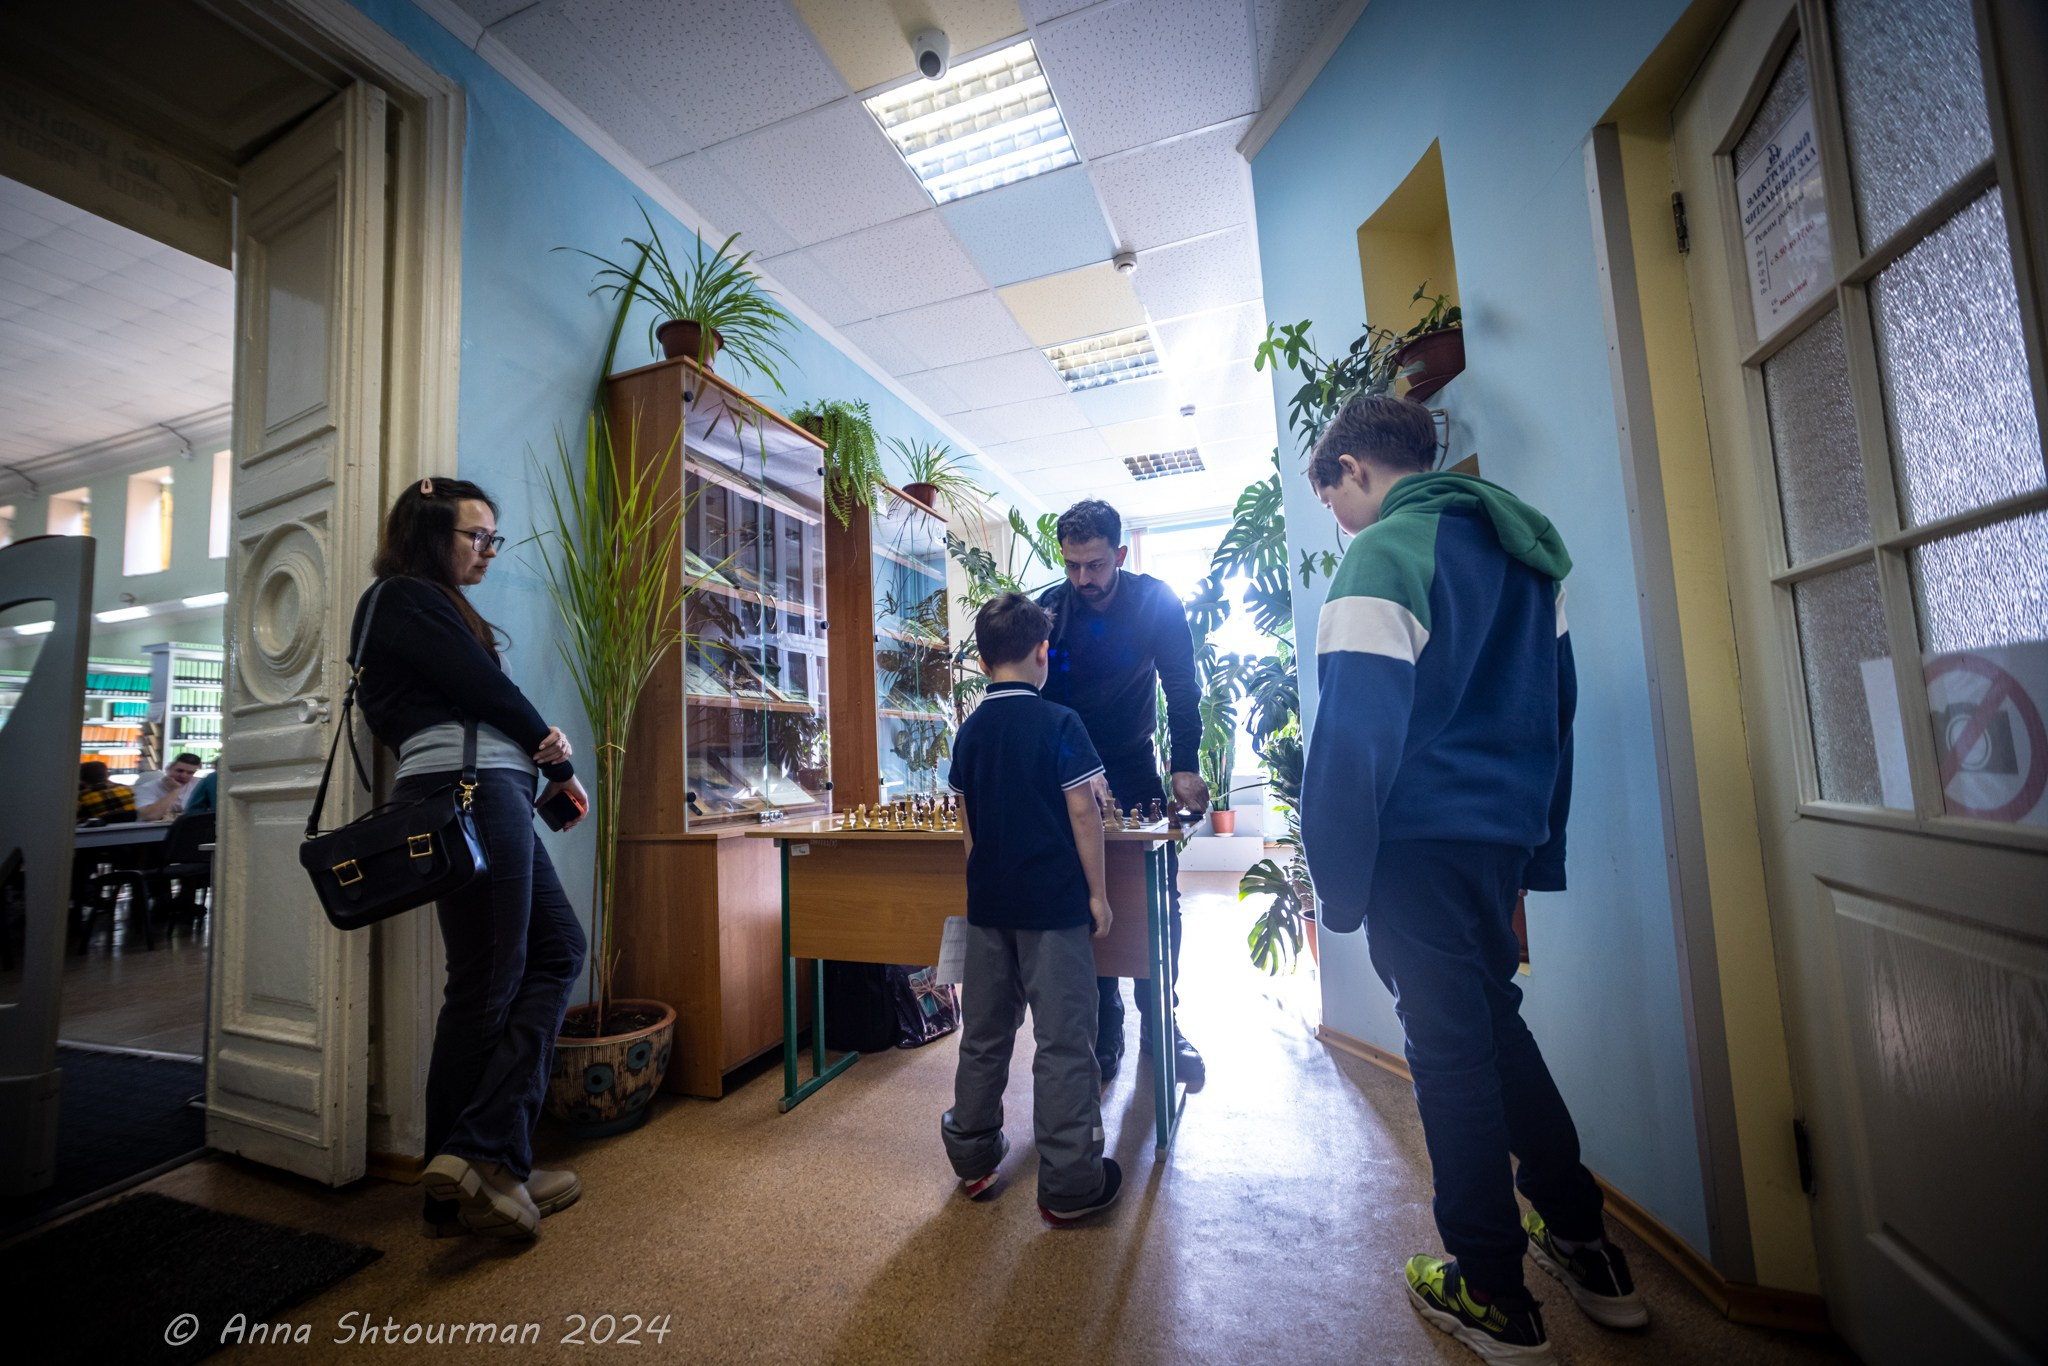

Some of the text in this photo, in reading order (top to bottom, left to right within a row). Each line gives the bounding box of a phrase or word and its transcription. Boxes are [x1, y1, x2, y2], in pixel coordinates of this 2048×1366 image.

[1744, 166, 1797, 225] ЧИТАЛЬНЫЙ
[1798, 147, 1817, 172] ЗАЛ
[1746, 130, 1811, 209] ЭЛЕКТРОННЫЙ
[1754, 191, 1805, 245] Режим работы
[1788, 240, 1797, 250] до
